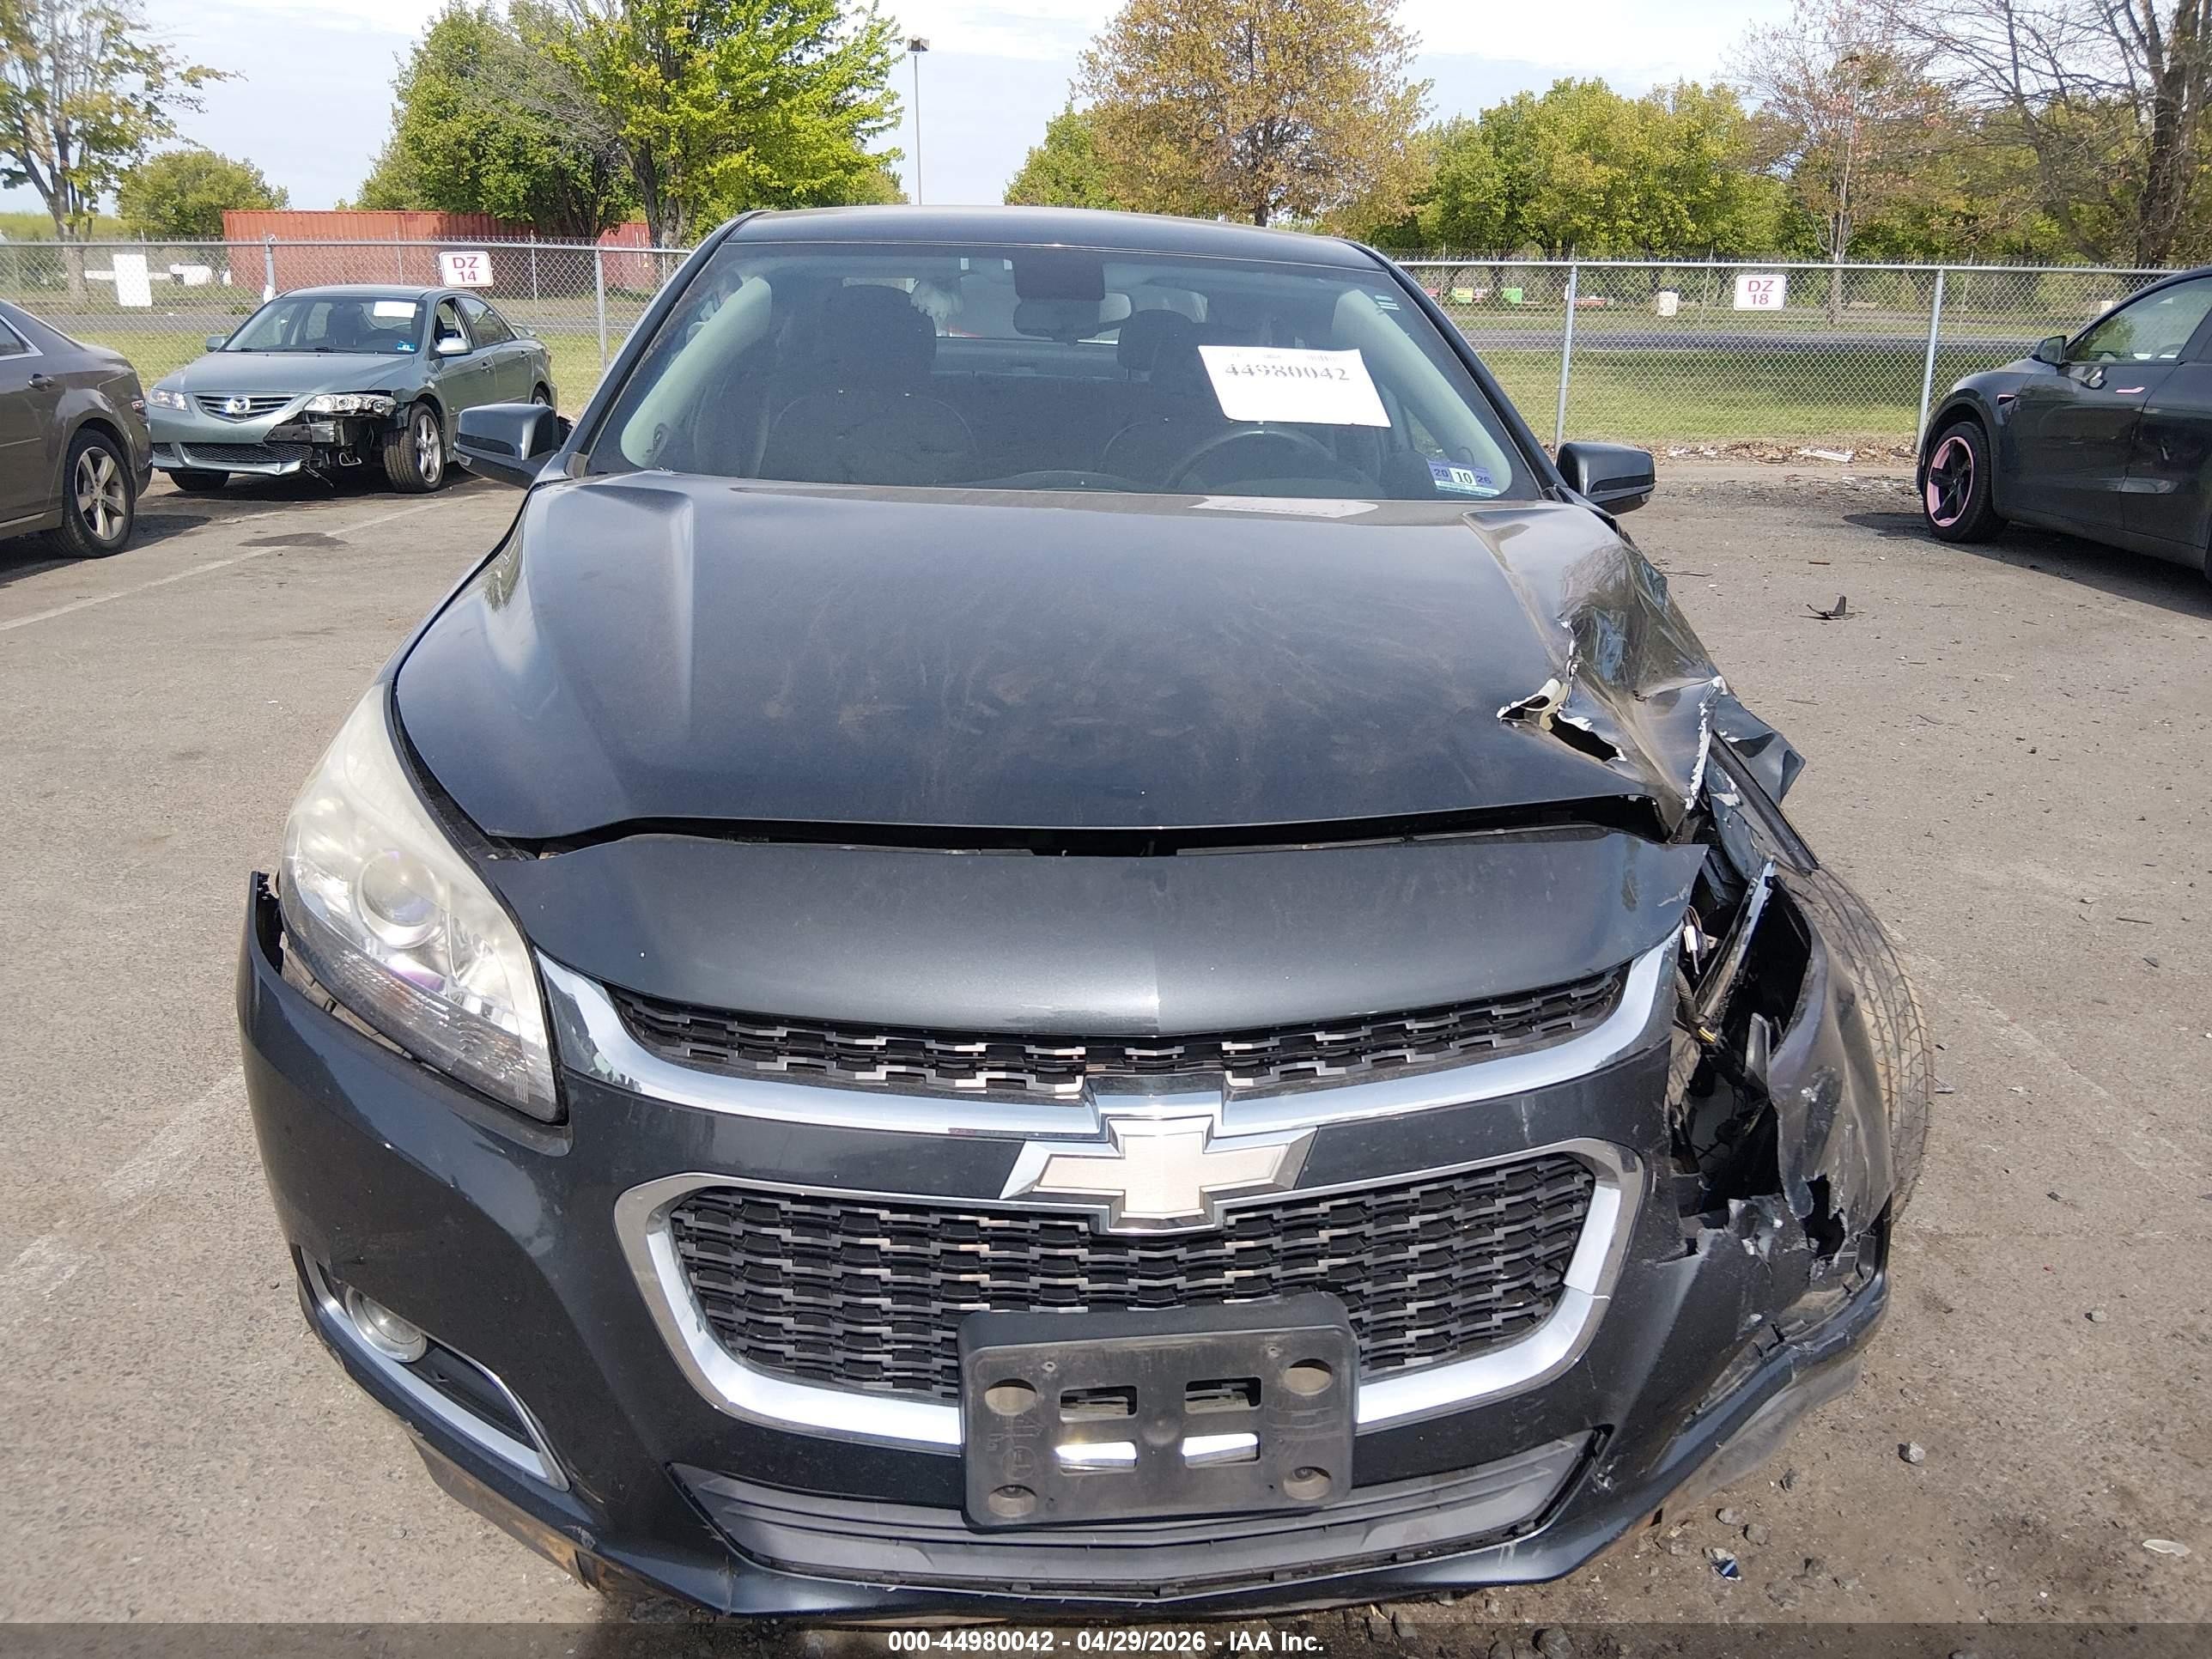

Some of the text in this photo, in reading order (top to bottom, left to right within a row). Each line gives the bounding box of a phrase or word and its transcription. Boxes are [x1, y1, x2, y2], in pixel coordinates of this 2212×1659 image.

[453, 257, 480, 269] DZ
[457, 270, 477, 283] 14
[1747, 280, 1775, 292] DZ
[1751, 293, 1769, 306] 18
[1224, 363, 1351, 381] 44980042
[1455, 471, 1473, 484] 10
